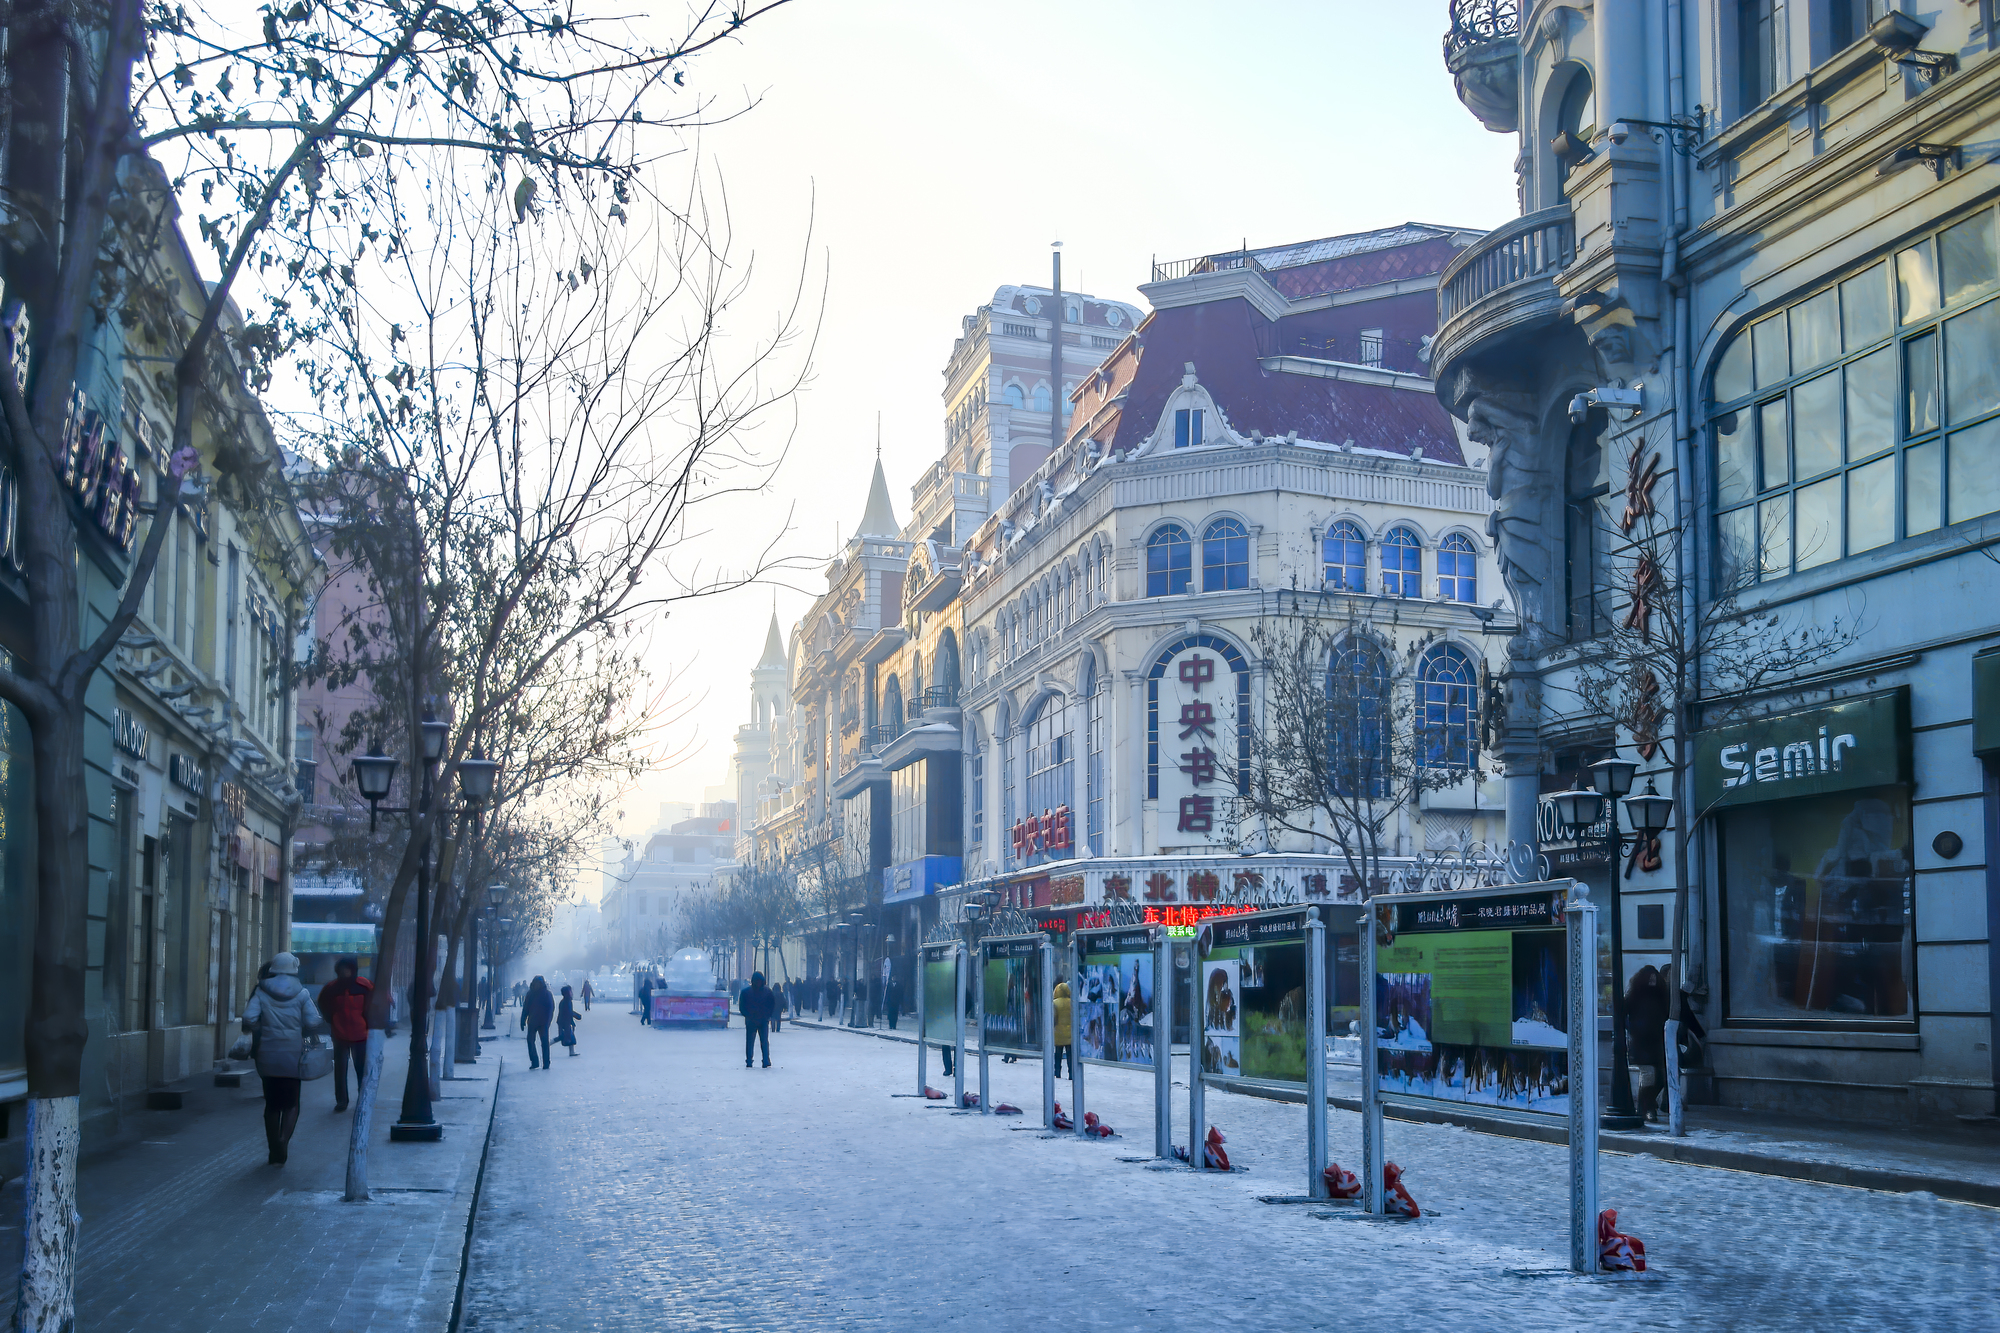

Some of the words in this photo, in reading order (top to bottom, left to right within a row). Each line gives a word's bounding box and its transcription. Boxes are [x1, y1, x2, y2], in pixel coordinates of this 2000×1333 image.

[1177, 654, 1216, 832] 中央书店
[1720, 725, 1856, 788] Semir
[1012, 803, 1070, 860] 中央书店
[1102, 869, 1266, 902] 东北特产
